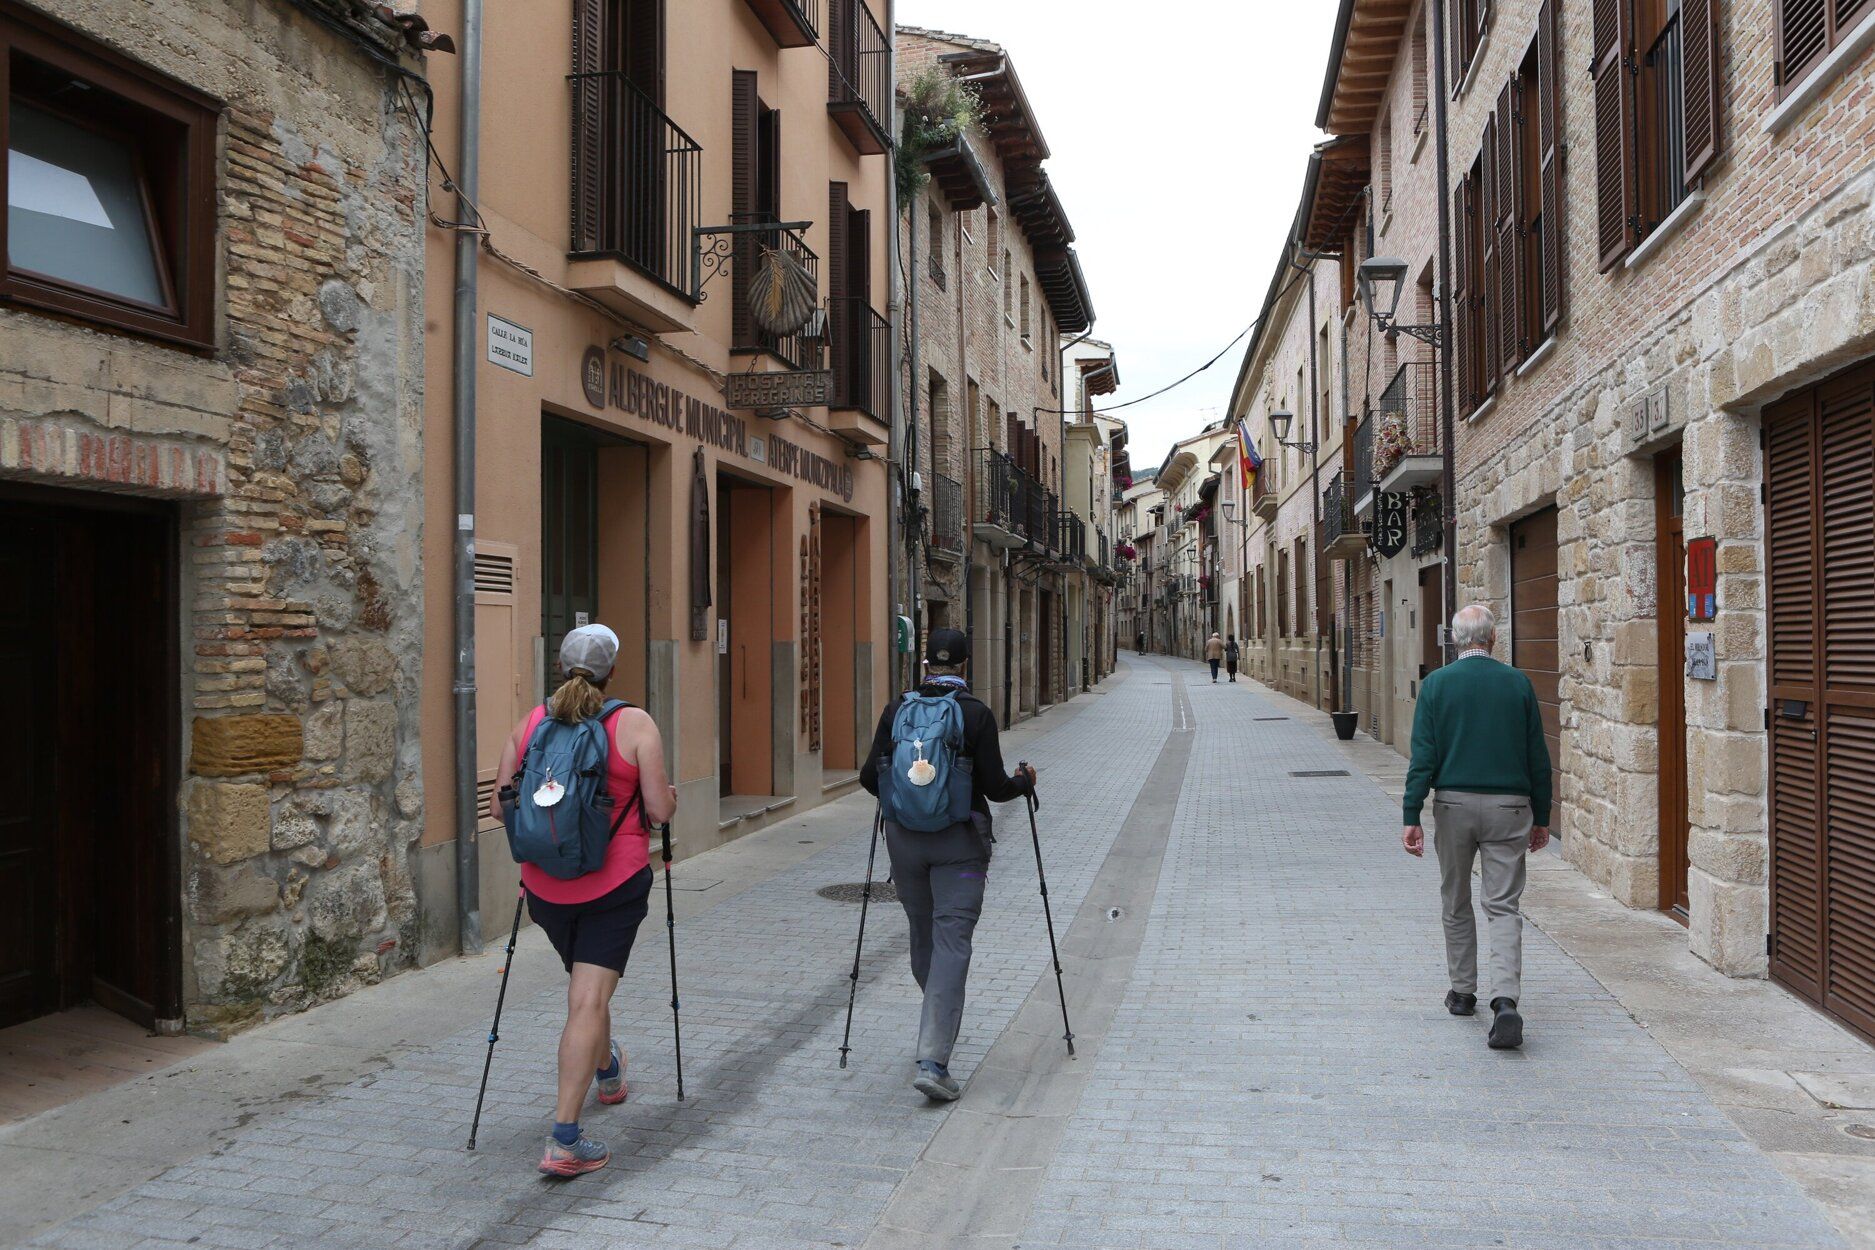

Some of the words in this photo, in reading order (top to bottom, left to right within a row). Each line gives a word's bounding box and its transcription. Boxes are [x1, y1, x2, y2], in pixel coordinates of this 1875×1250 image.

[491, 326, 507, 340] CALLE
[509, 333, 516, 343] LA
[734, 373, 825, 390] HOSPITAL
[731, 387, 825, 405] PEREGRINOS
[608, 360, 684, 434] ALBERGUE
[686, 394, 749, 458] MUNICIPAL
[1634, 409, 1644, 431] 35
[1654, 396, 1664, 421] 37
[767, 432, 800, 479] ATERPE
[800, 447, 844, 497] MUNIZIPALA
[1386, 491, 1403, 547] BAR
